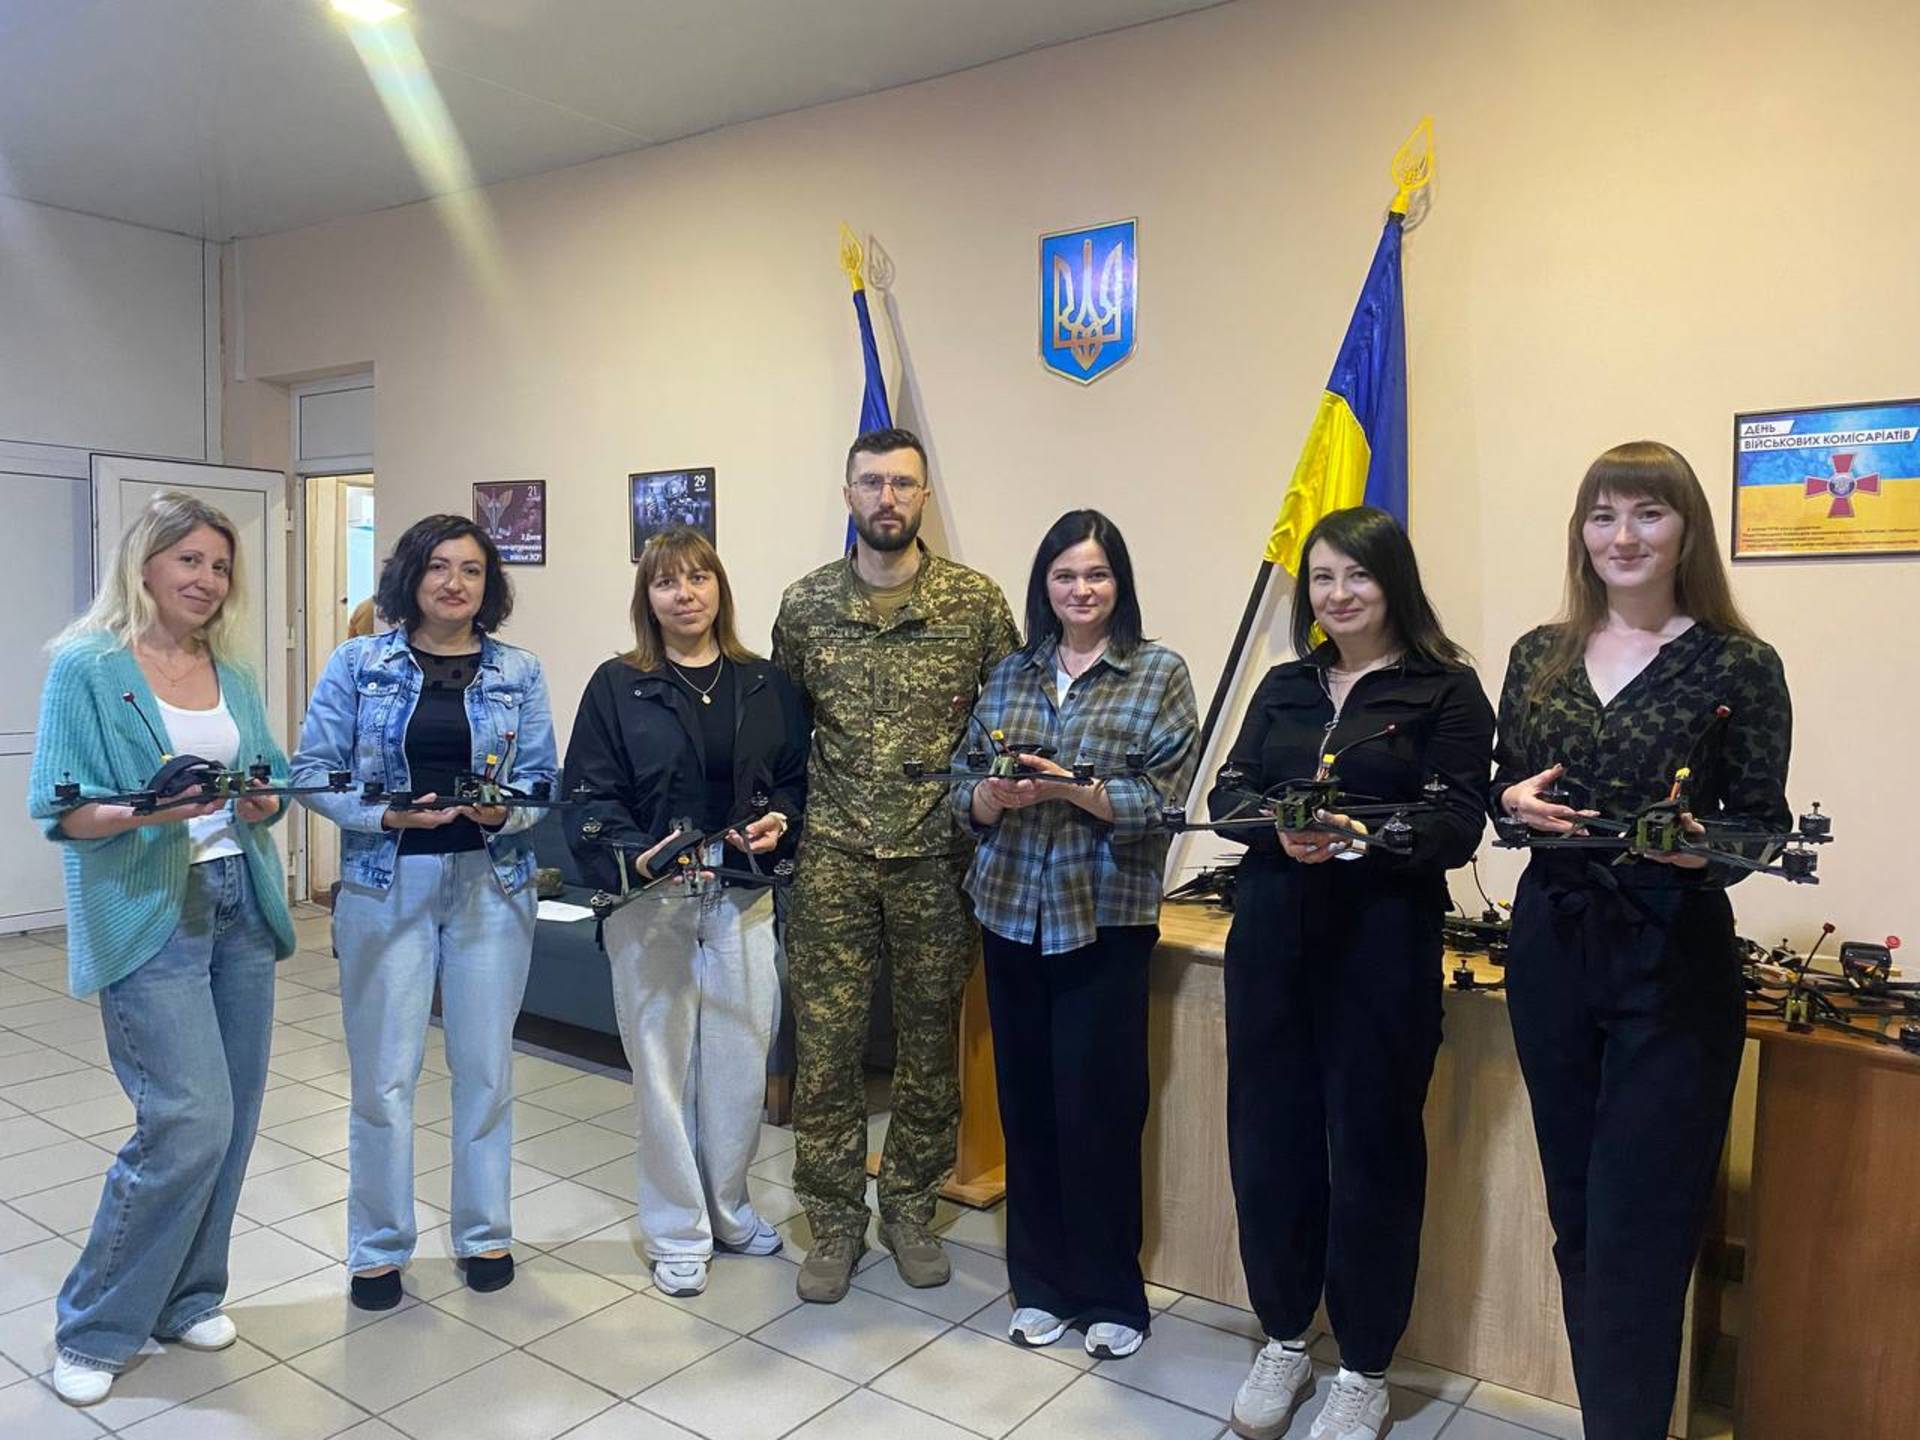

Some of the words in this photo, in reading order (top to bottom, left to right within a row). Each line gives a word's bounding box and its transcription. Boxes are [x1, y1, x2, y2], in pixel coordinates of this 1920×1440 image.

[1744, 423, 1776, 435] ДЕНЬ
[1744, 436, 1821, 449] ВІЙСЬКОВИХ
[1823, 430, 1911, 445] КОМІСАРІАТІВ
[694, 474, 706, 487] 29
[527, 485, 537, 497] 21
